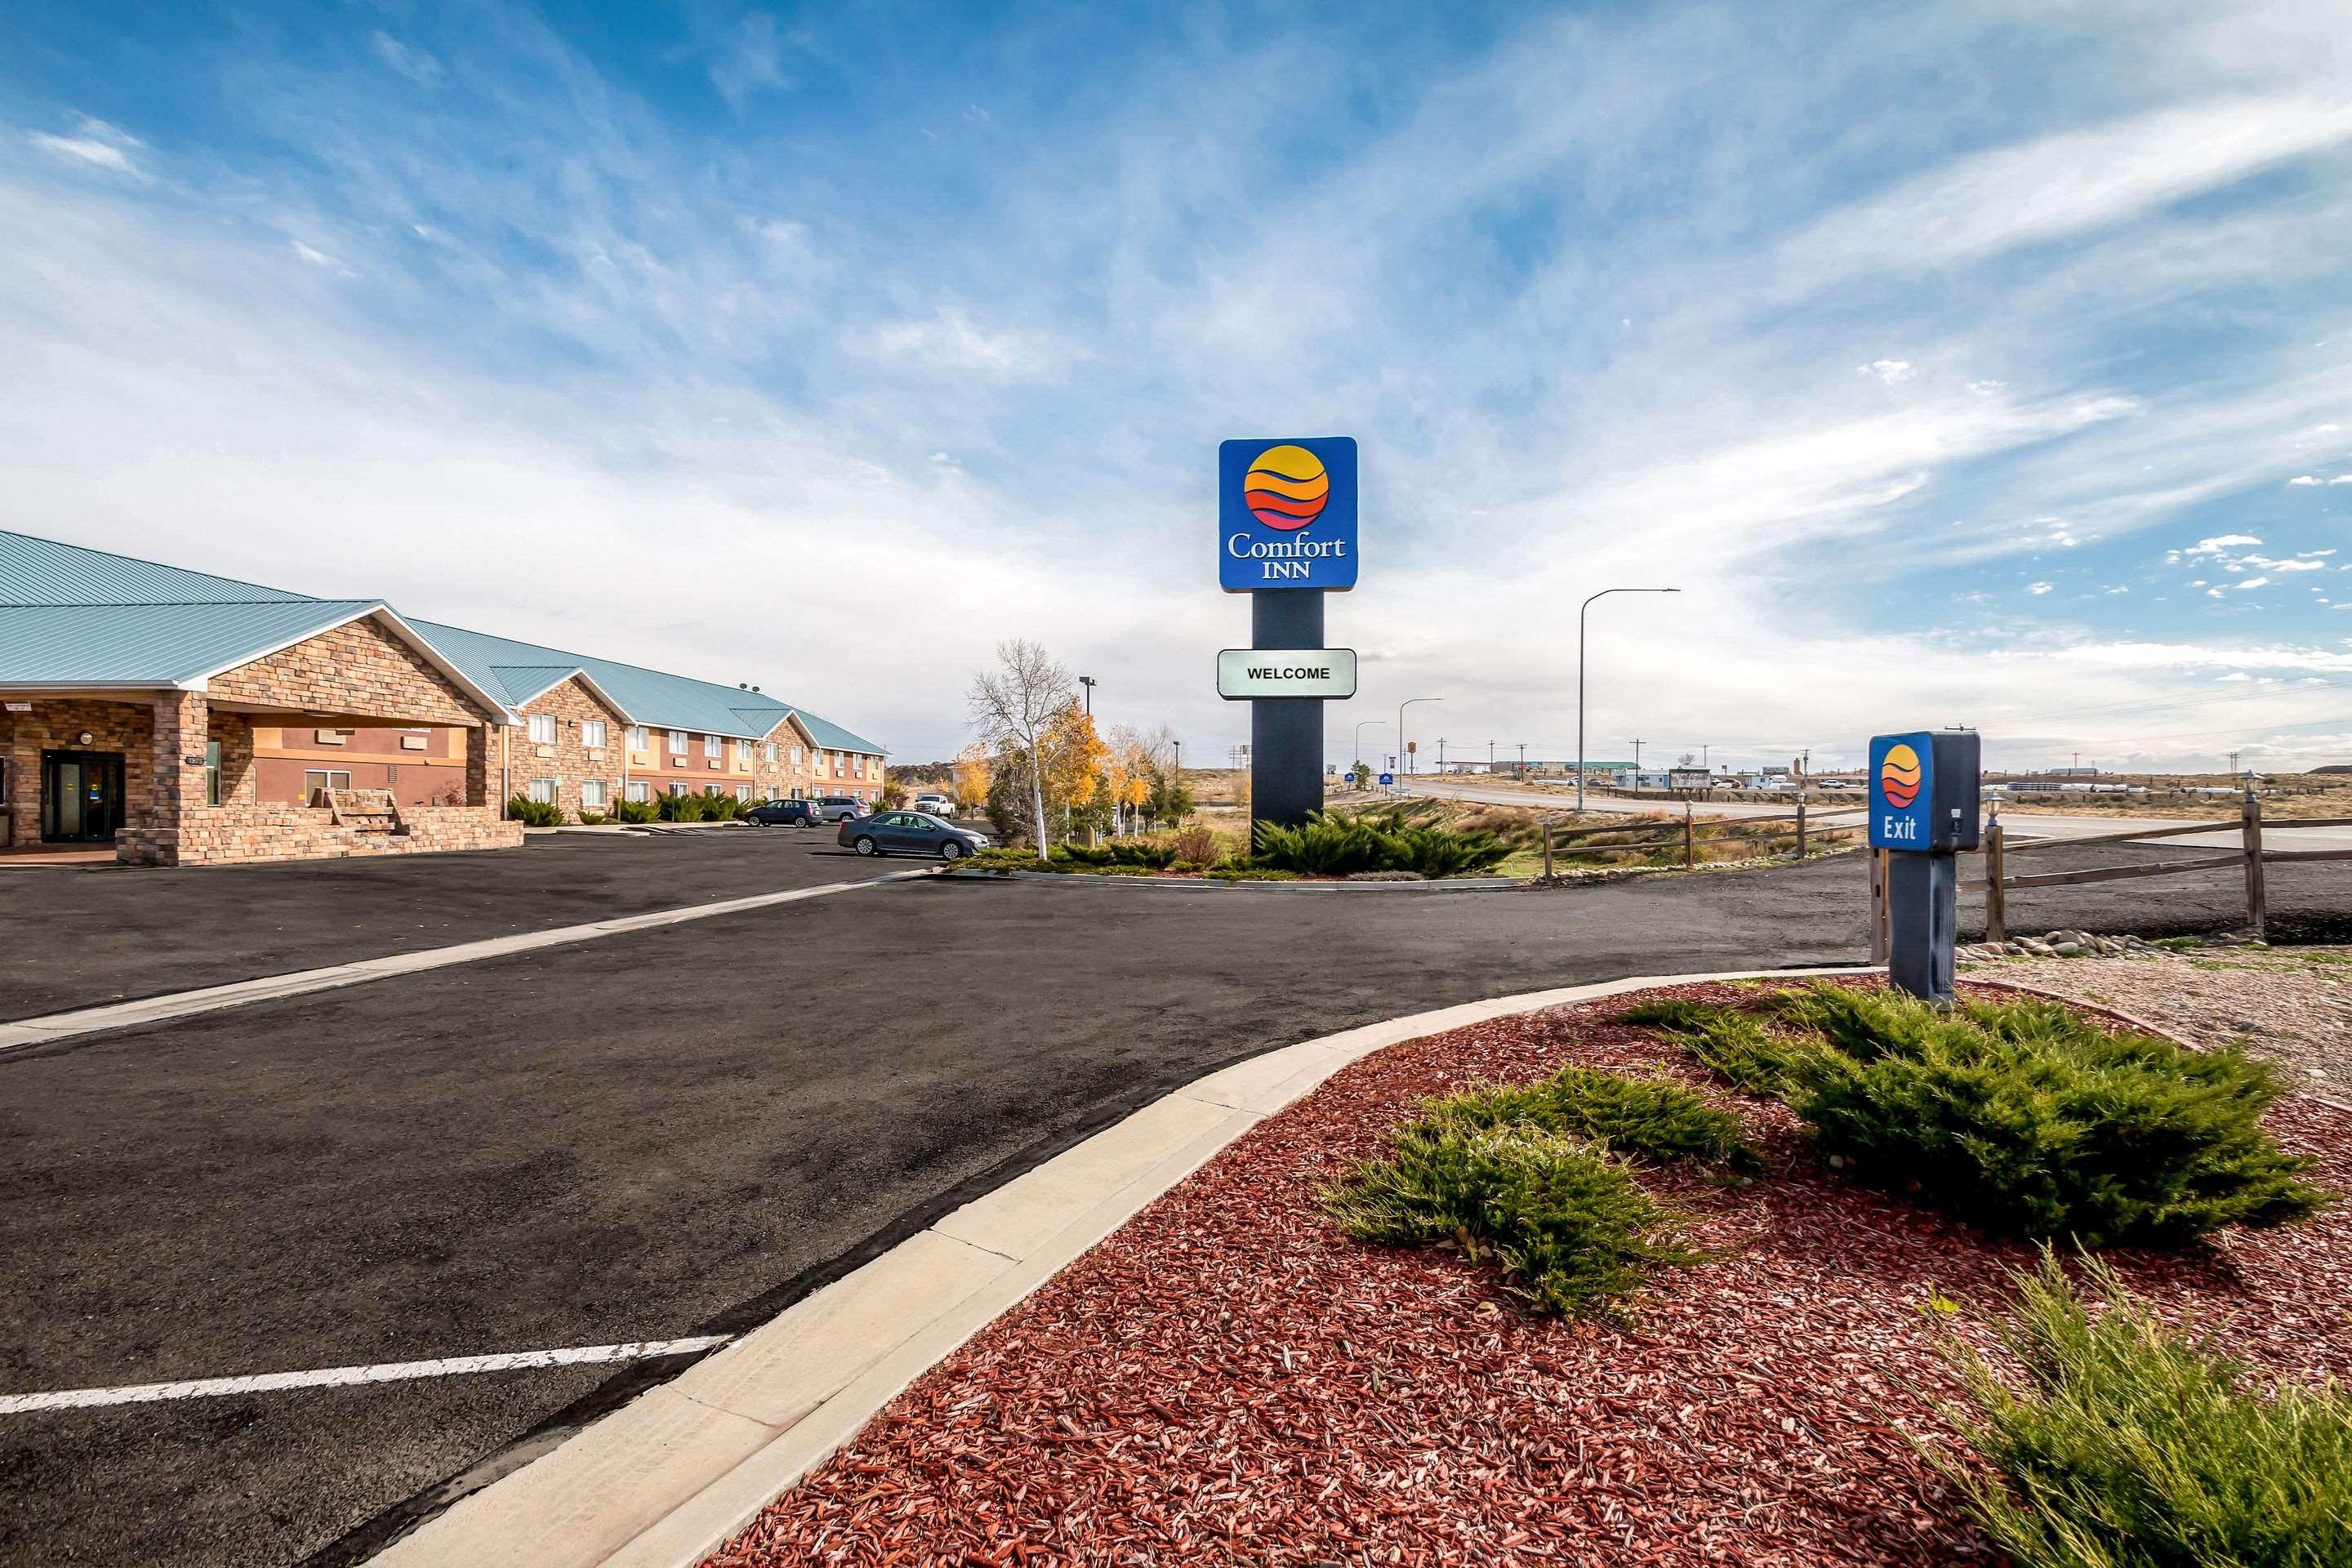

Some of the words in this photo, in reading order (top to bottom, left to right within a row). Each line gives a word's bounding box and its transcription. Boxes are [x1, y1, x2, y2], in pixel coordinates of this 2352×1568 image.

[1227, 532, 1346, 559] Comfort
[1262, 561, 1312, 580] INN
[1247, 667, 1330, 679] WELCOME
[1883, 815, 1917, 840] Exit
